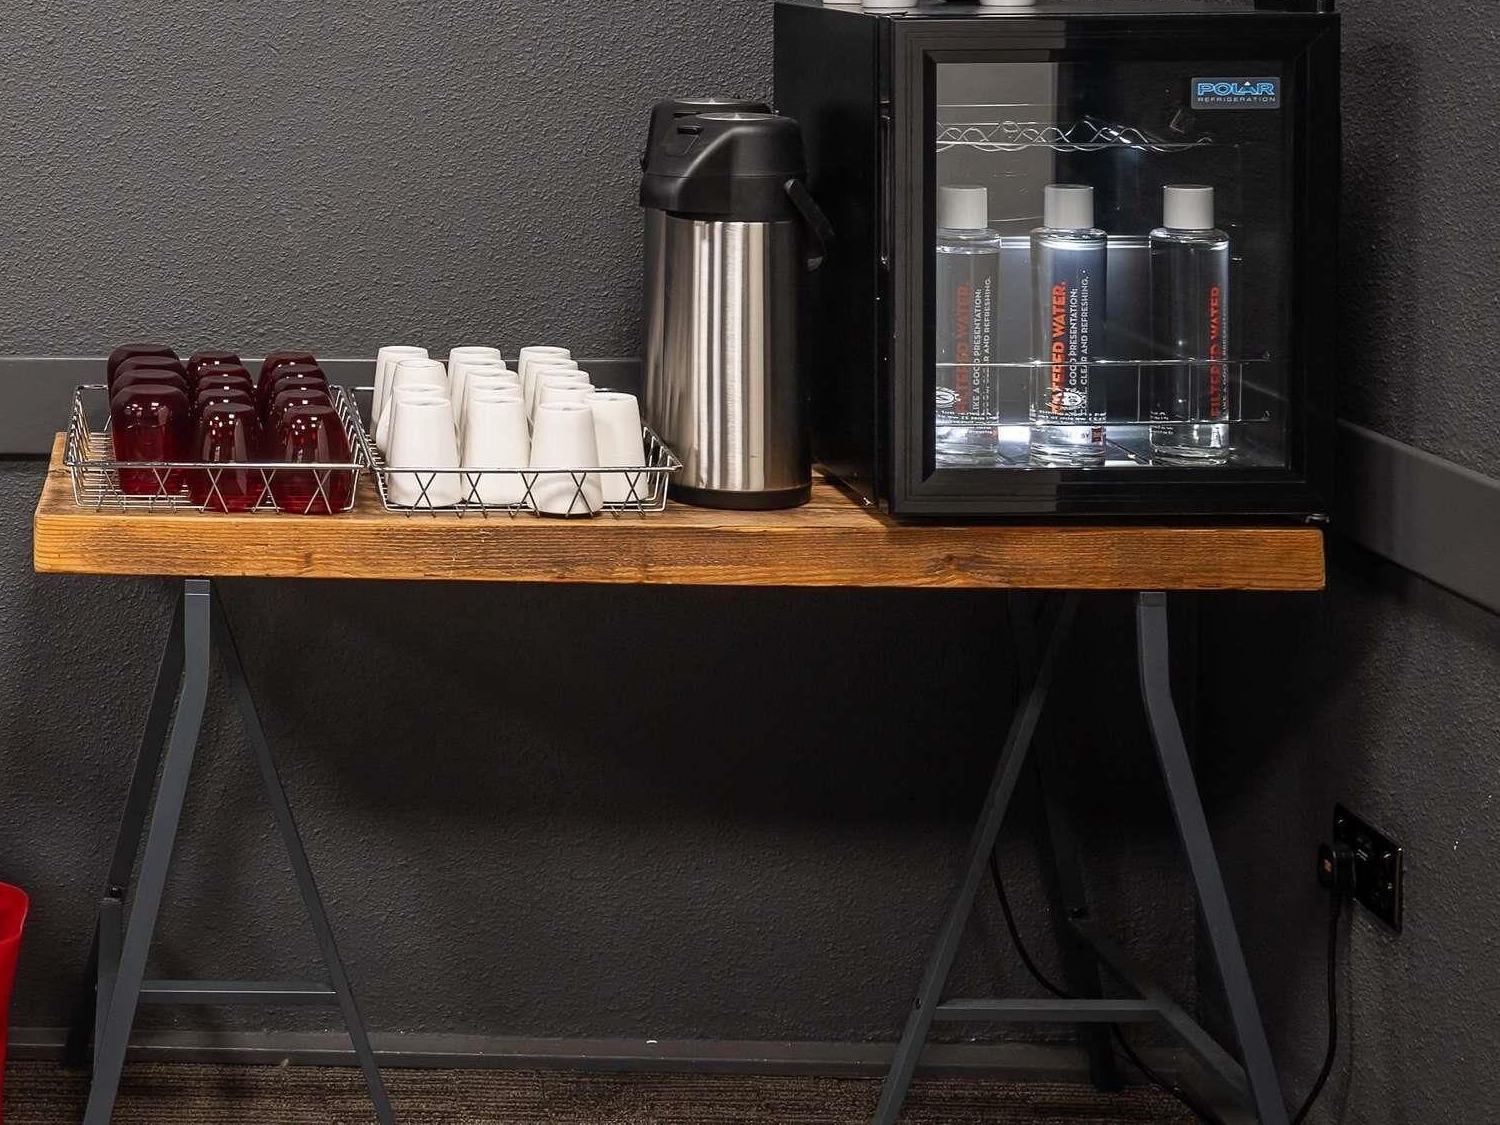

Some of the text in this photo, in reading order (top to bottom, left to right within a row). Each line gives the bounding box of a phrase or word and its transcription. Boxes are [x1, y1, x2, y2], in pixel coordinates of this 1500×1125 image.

[1197, 81, 1276, 96] POLAR
[1052, 281, 1067, 338] WATER.
[1081, 334, 1089, 355] AND
